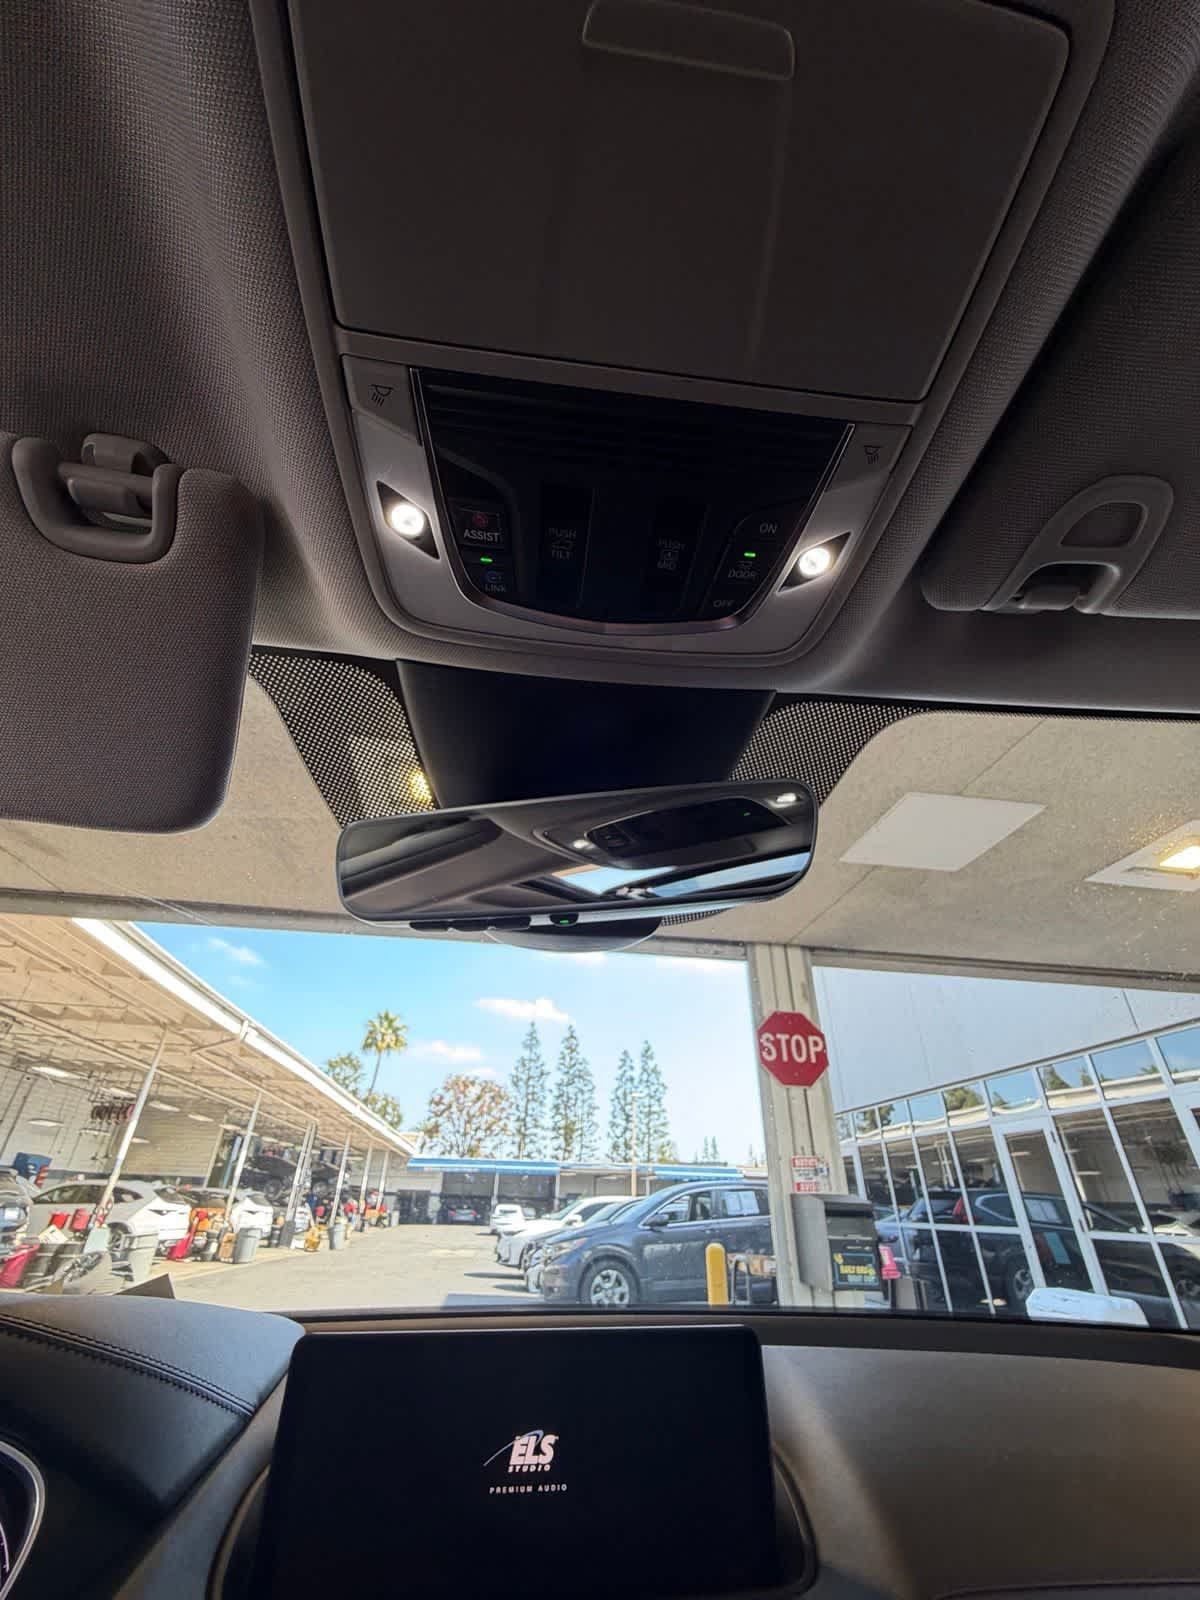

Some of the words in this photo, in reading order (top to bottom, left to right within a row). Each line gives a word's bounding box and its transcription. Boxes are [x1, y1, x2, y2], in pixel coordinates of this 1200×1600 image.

[759, 522, 777, 534] ON
[463, 529, 500, 543] ASSIST
[760, 1032, 824, 1063] STOP
[509, 1434, 555, 1464] ELS
[508, 1464, 551, 1473] STUDIO
[489, 1486, 533, 1494] PREMIUM
[538, 1484, 567, 1492] AUDIO
